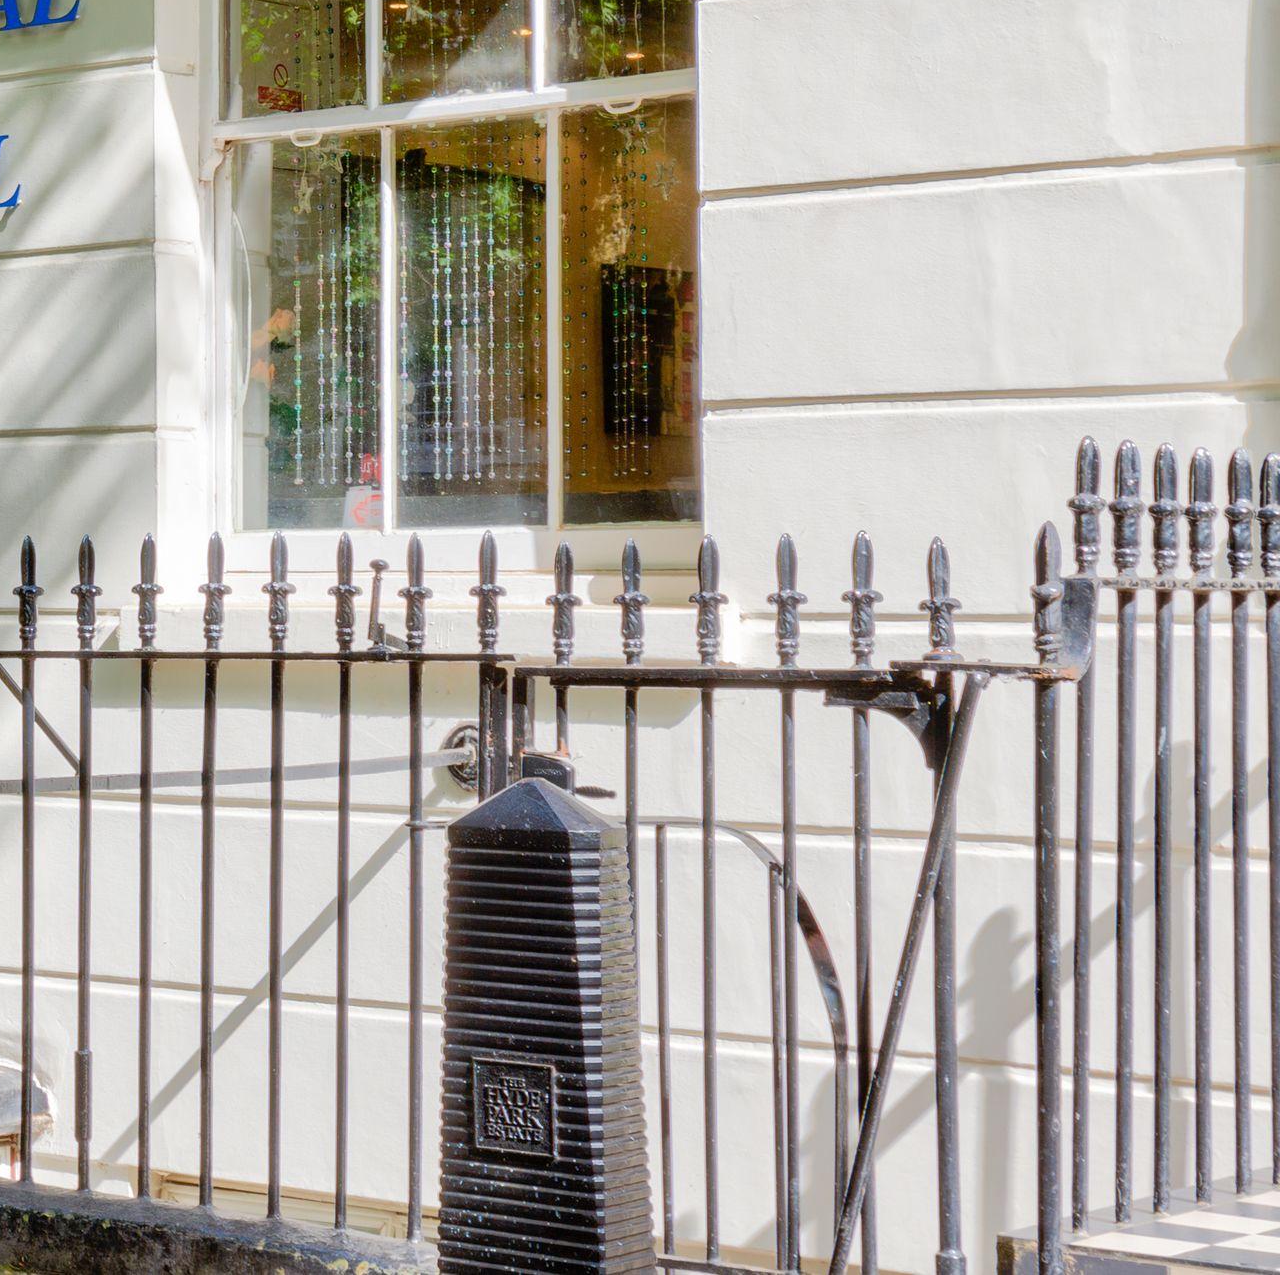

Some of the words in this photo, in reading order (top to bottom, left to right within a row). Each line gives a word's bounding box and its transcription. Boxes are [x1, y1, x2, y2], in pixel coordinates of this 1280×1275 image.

[499, 1076, 526, 1087] THE
[483, 1084, 541, 1108] HYDE
[484, 1103, 544, 1129] PARK
[484, 1122, 544, 1142] ESTATE
